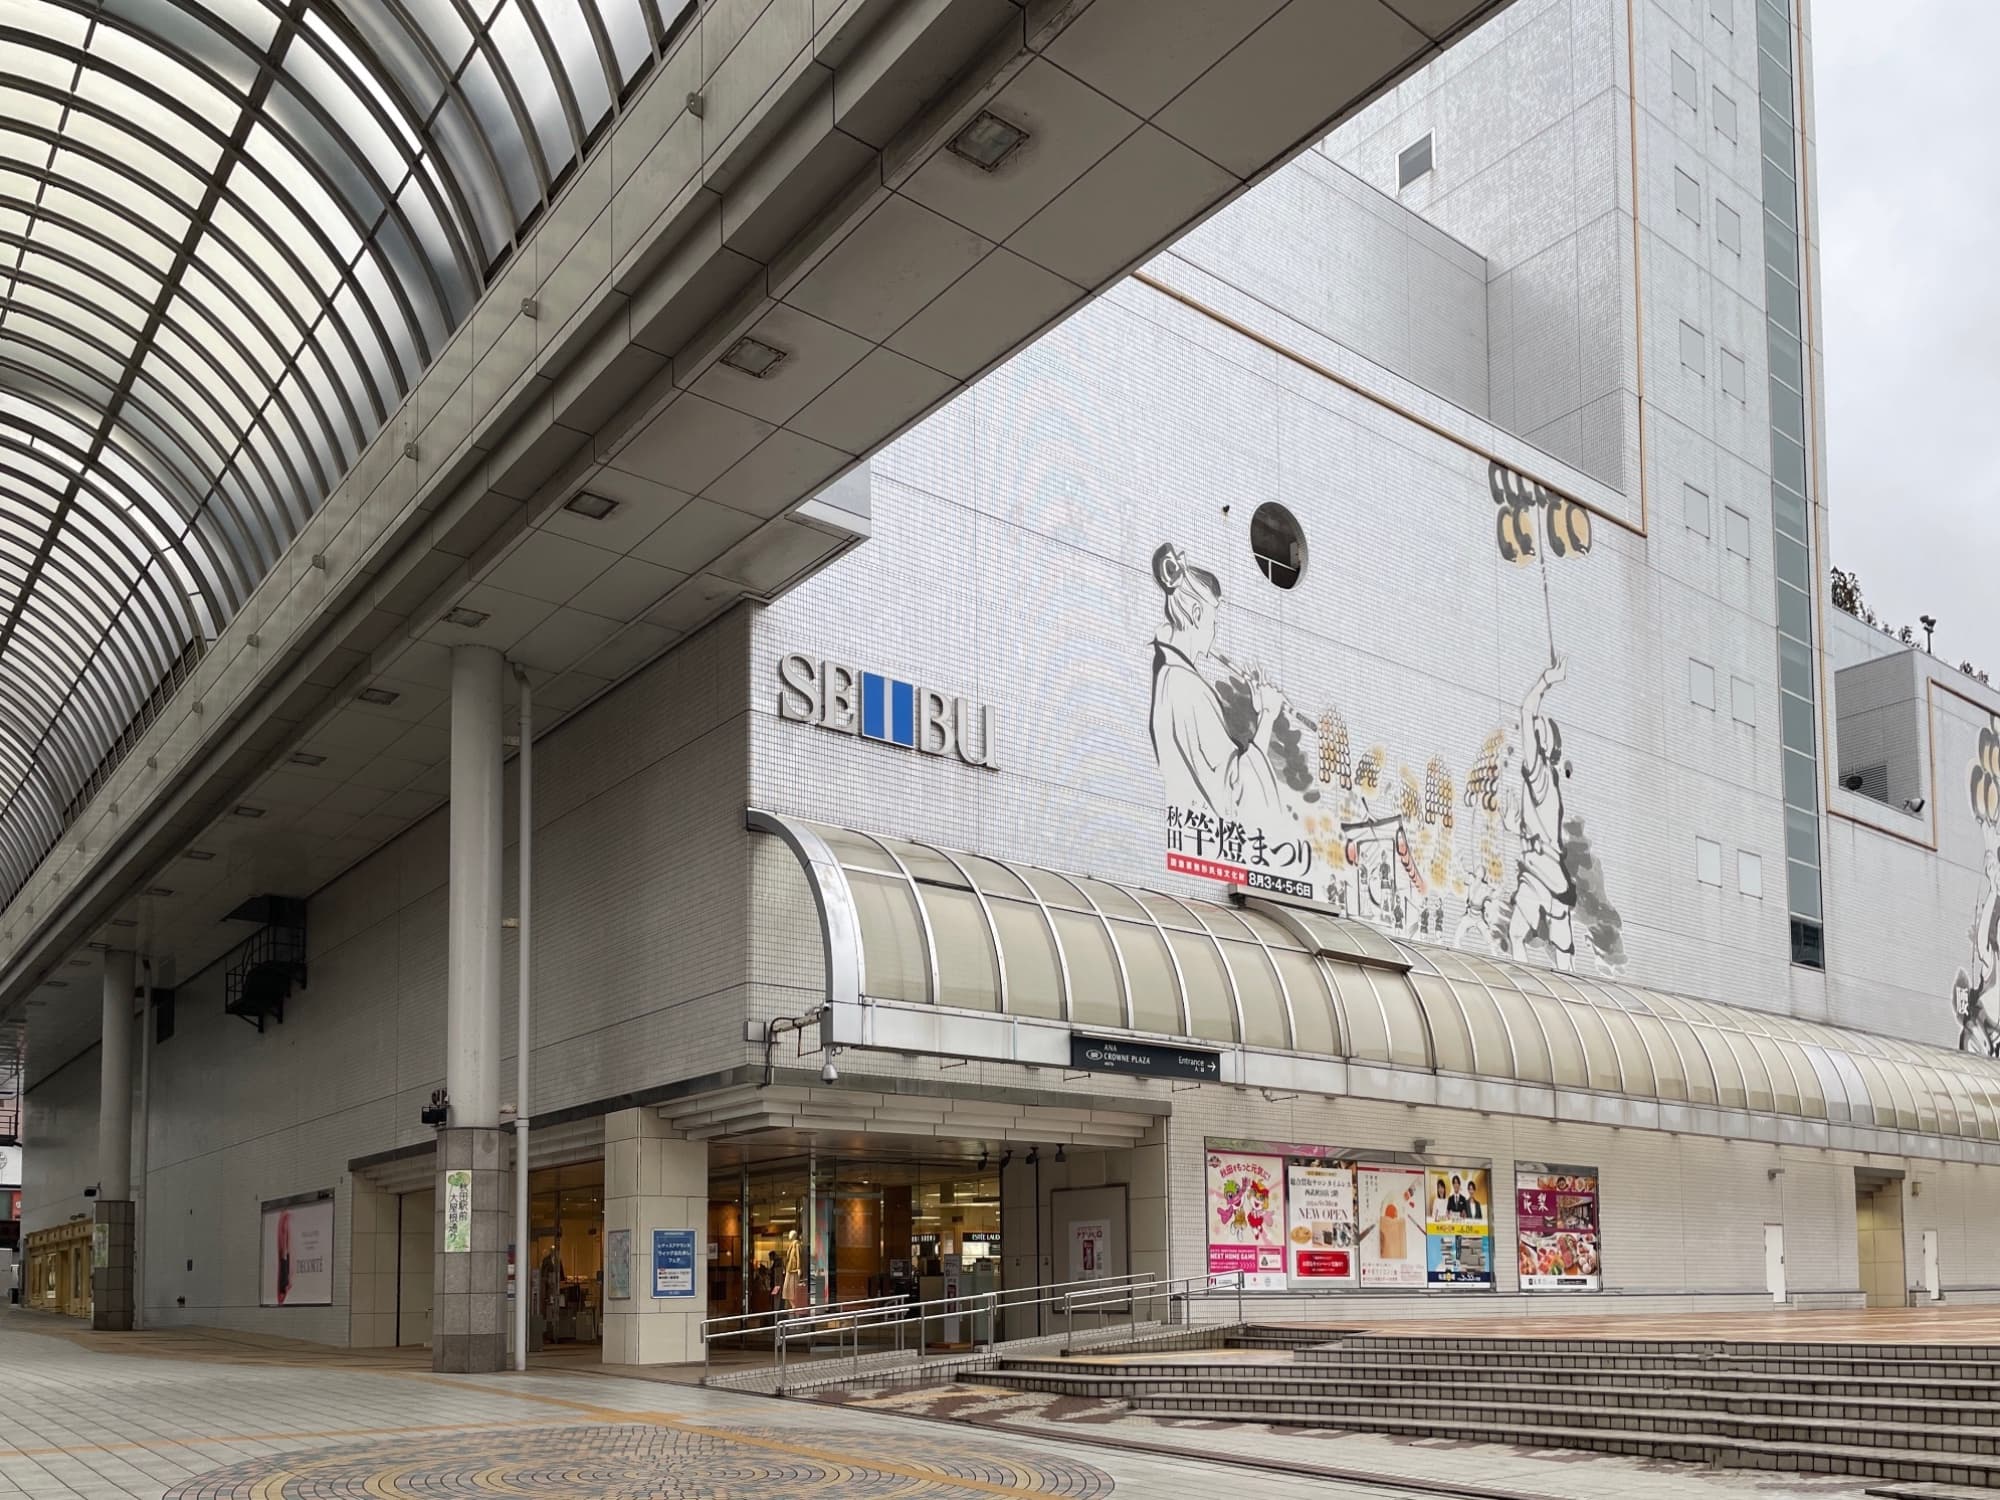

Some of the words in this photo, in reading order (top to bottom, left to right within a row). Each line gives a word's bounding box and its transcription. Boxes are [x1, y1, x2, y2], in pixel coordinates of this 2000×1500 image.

[779, 651, 1000, 771] SEIBU
[1166, 804, 1183, 851] 秋田
[1184, 808, 1312, 876] 竿燈まつり
[1103, 1052, 1129, 1062] CROWNE
[1131, 1055, 1151, 1065] PLAZA
[1178, 1055, 1205, 1067] Entrance
[1298, 1207, 1320, 1219] NEW
[1322, 1208, 1349, 1220] OPEN
